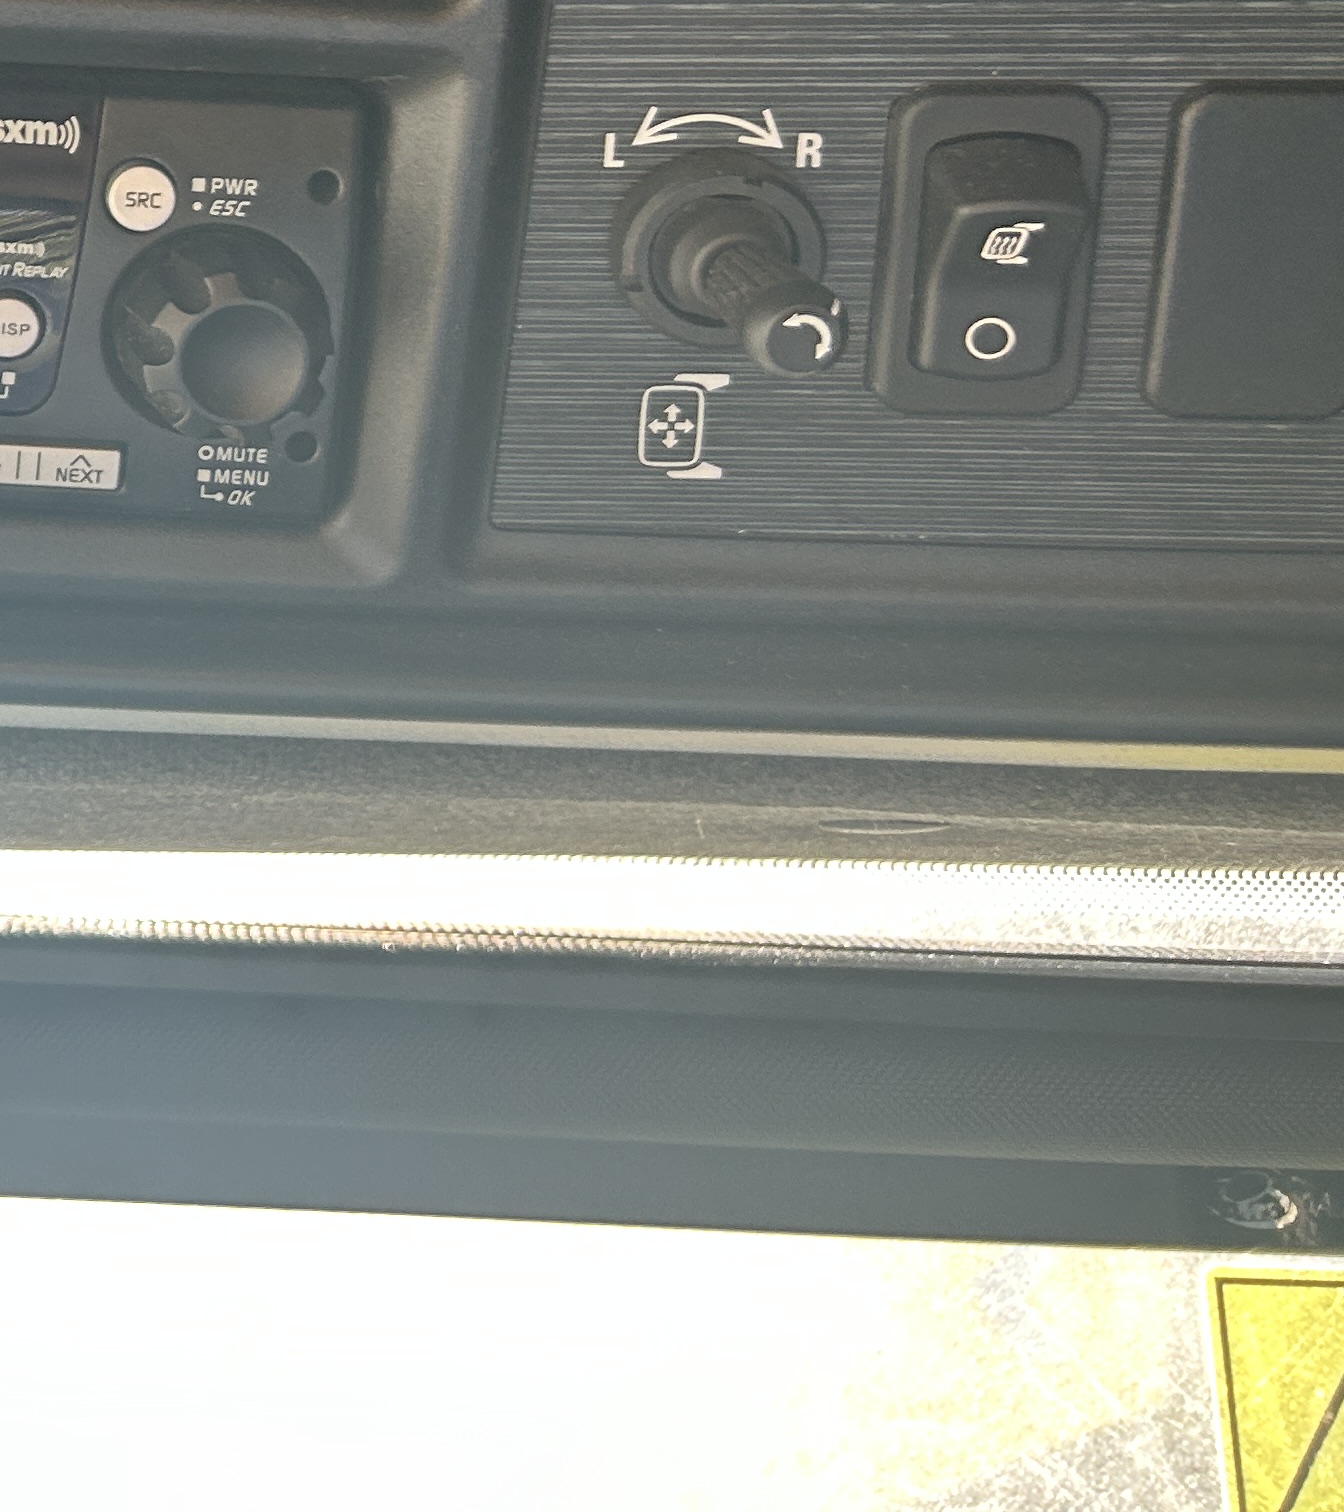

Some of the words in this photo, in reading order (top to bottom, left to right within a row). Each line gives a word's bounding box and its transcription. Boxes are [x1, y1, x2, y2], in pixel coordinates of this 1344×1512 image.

[602, 132, 625, 168] L
[796, 133, 824, 169] R
[210, 176, 259, 197] PWR
[124, 190, 163, 211] SRC
[208, 197, 251, 219] ESC
[215, 446, 268, 464] MUTE
[55, 465, 104, 485] NEXT
[214, 468, 270, 487] MENU
[228, 490, 256, 506] OK
